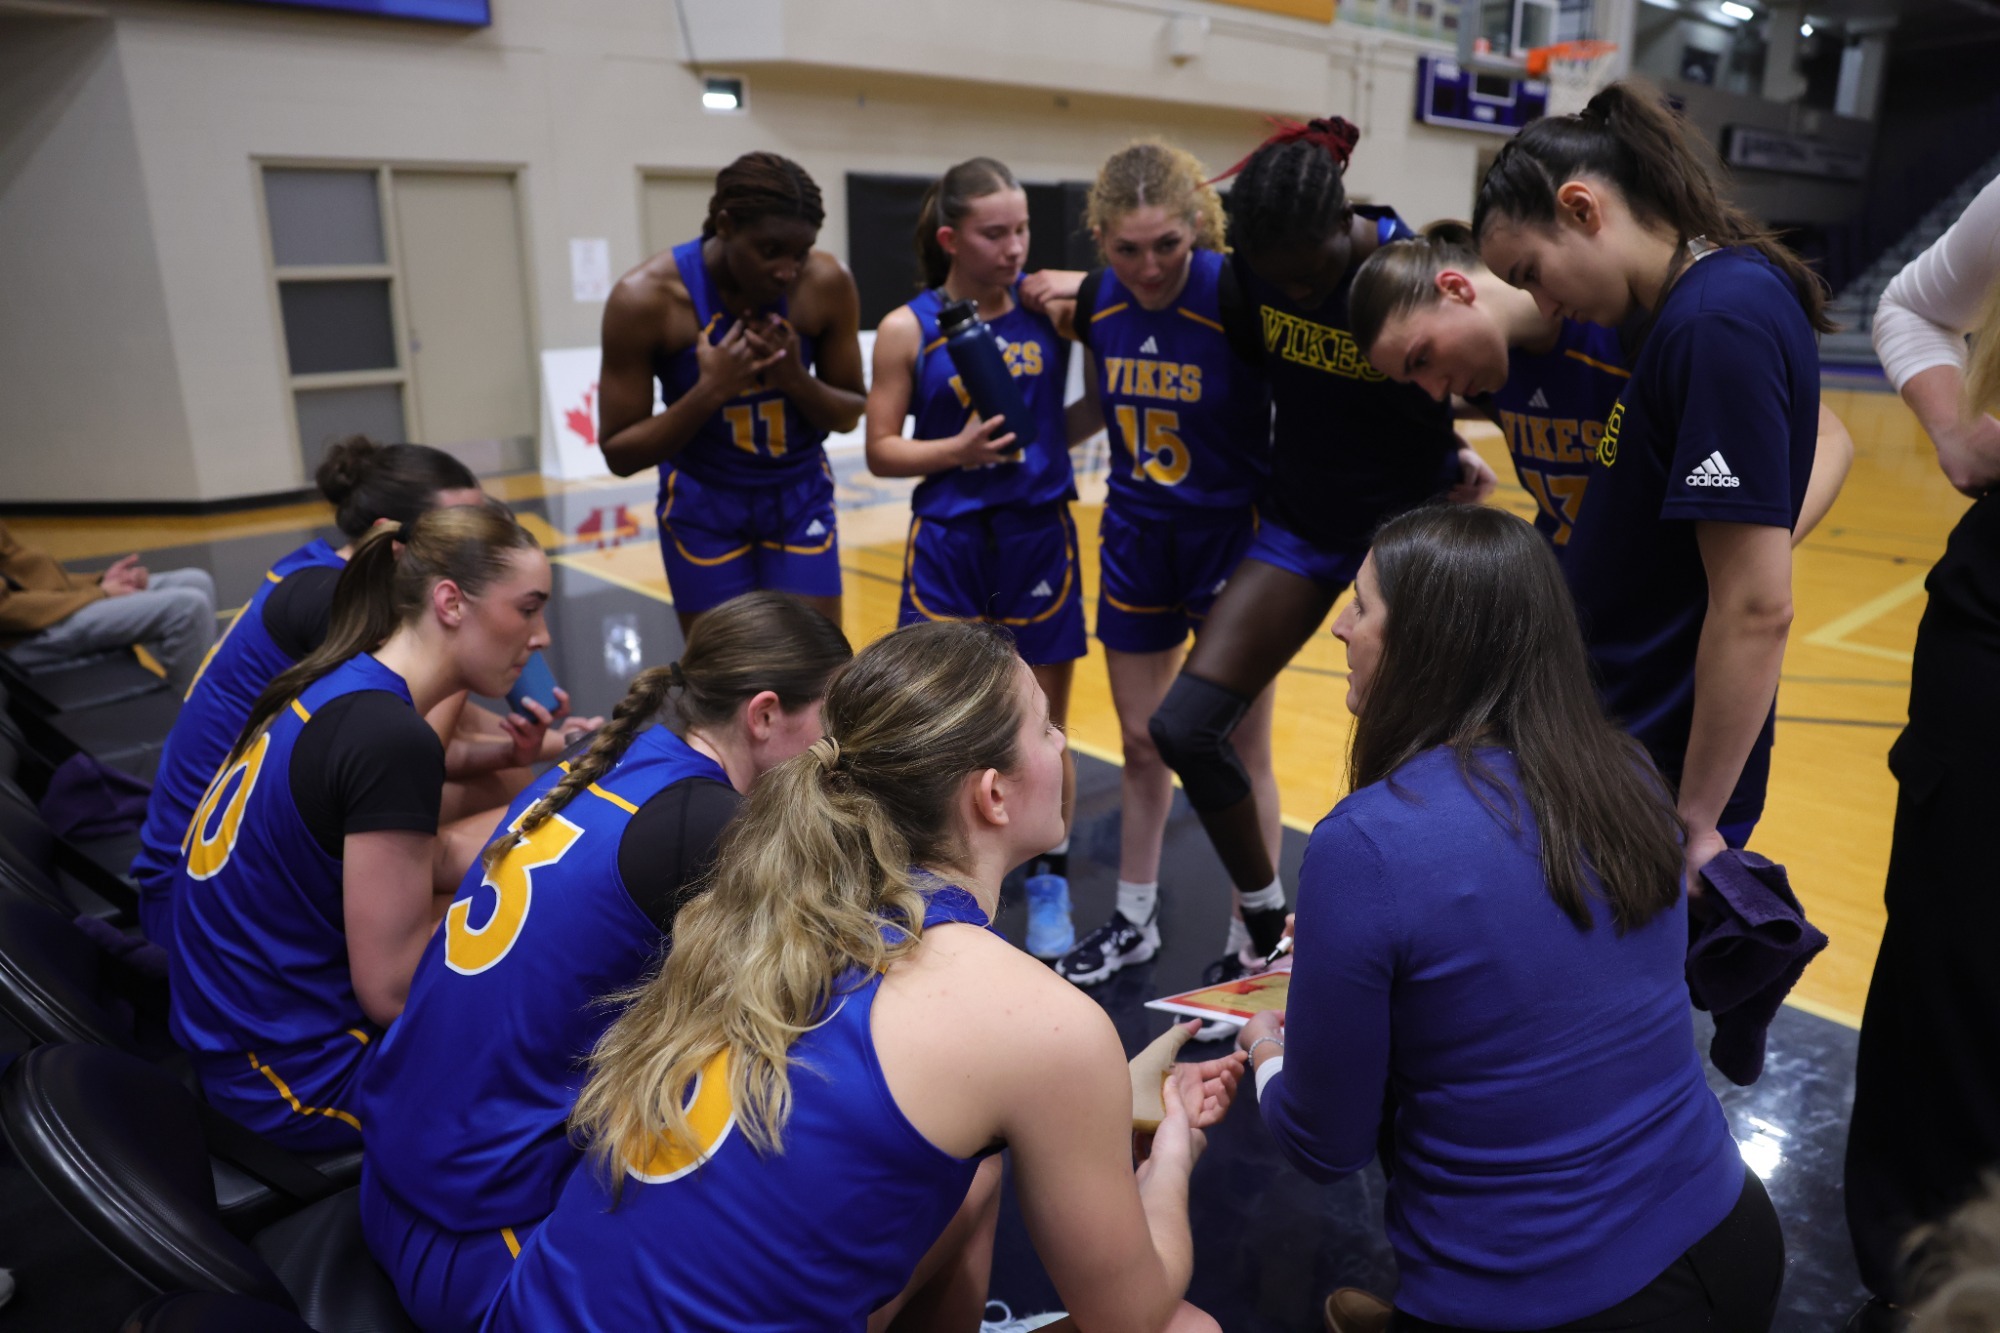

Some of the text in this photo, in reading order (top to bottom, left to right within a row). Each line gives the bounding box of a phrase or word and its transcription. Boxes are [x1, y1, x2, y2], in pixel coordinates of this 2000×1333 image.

[1105, 356, 1202, 403] VIKES
[1260, 304, 1389, 382] VIKE
[722, 398, 787, 458] 11
[1115, 404, 1191, 486] 15
[1519, 466, 1589, 546] 17
[1685, 473, 1740, 487] adidas
[444, 797, 585, 976] 3
